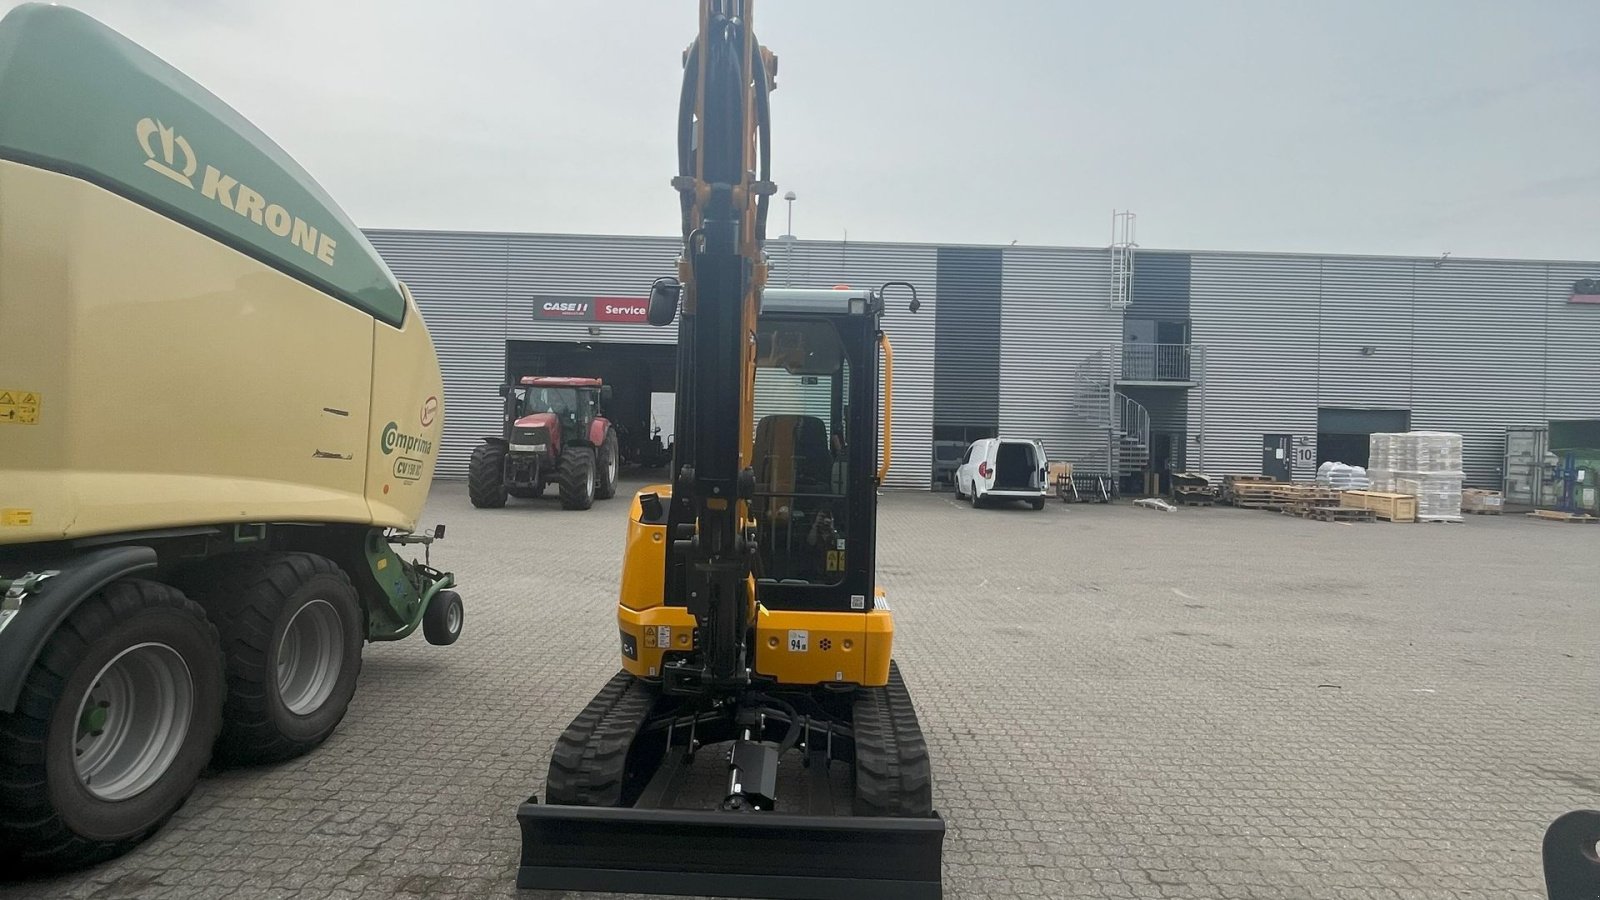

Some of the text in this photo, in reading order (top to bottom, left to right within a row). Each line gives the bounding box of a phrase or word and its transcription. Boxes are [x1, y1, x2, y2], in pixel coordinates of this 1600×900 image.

[201, 164, 337, 266] KRONE
[543, 302, 576, 311] CASE
[605, 305, 646, 315] Service
[381, 421, 432, 455] Comprima
[1299, 449, 1312, 460] 10
[397, 461, 408, 474] CV
[791, 639, 801, 650] 94
